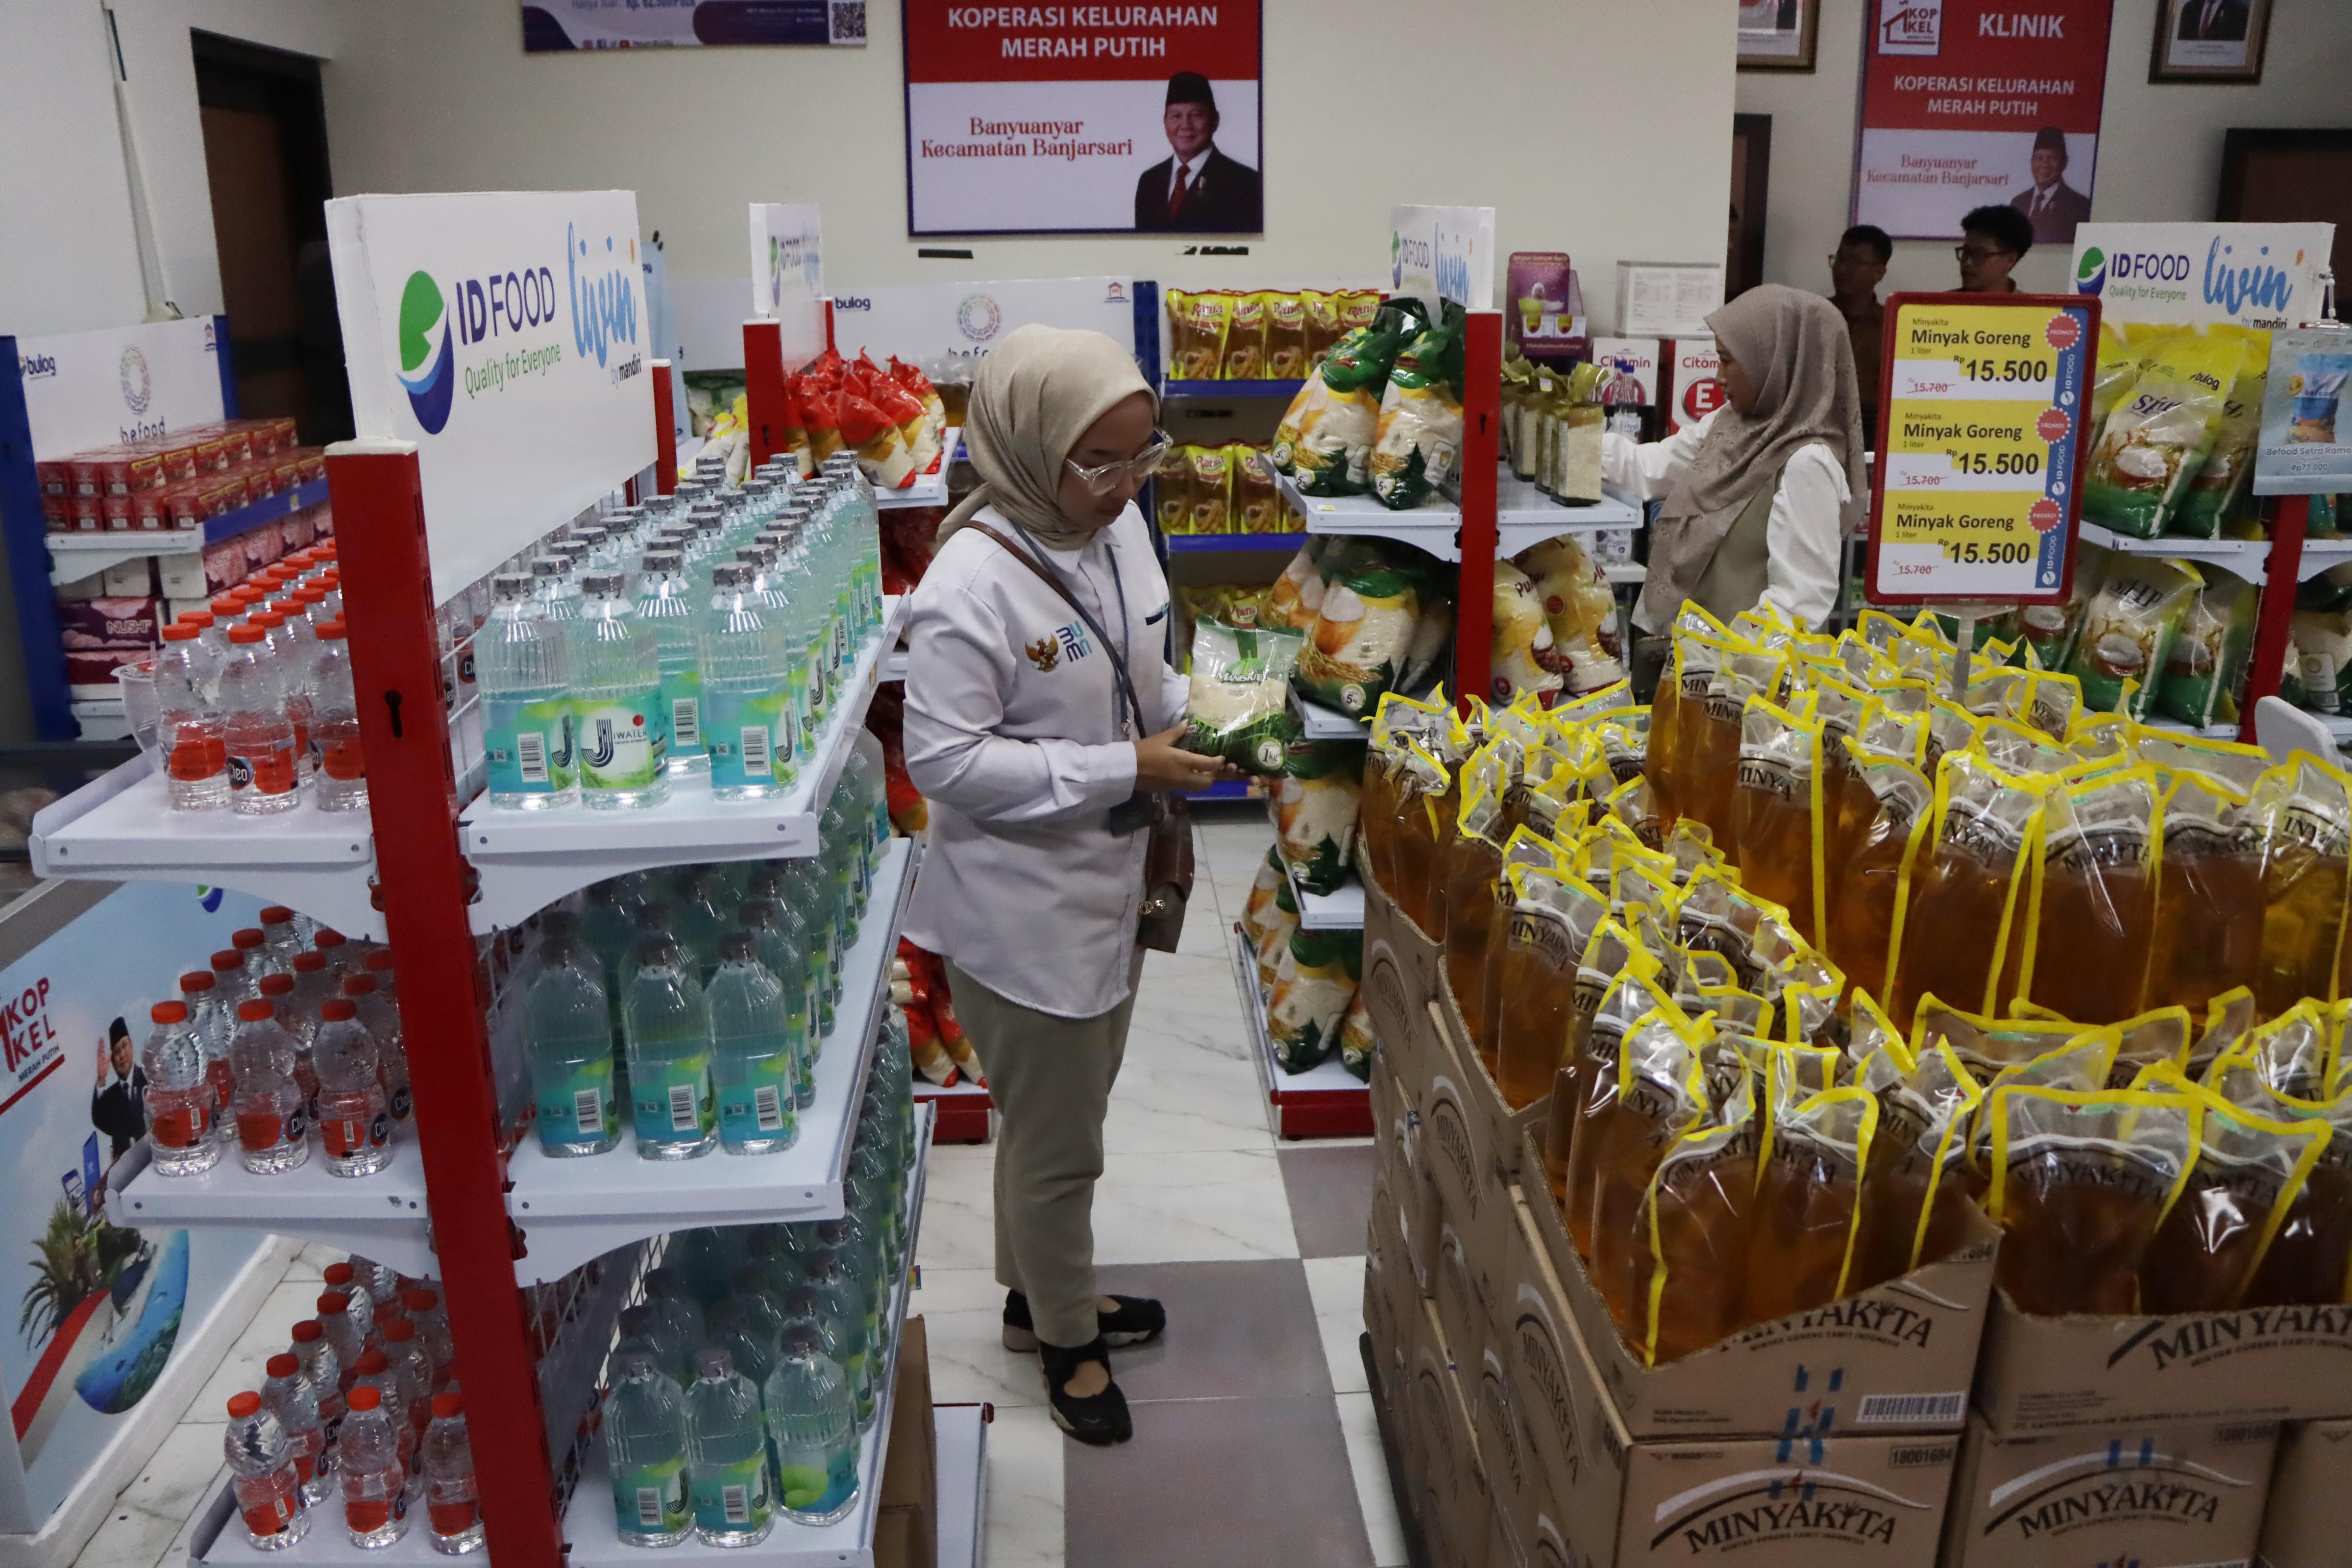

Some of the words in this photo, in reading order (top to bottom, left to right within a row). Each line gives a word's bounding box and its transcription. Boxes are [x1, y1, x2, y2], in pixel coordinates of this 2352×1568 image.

[949, 8, 1065, 27] KOPERASI
[1072, 6, 1218, 26] KELURAHAN
[1909, 7, 1937, 21] KOP
[1908, 21, 1934, 34] KEL
[1979, 13, 2065, 38] KLINIK
[1002, 38, 1087, 58] MERAH
[1094, 37, 1166, 57] PUTIH
[1893, 75, 1973, 92] KOPERASI
[1976, 77, 2075, 95] KELURAHAN
[1927, 99, 1985, 114] MERAH
[1989, 100, 2038, 116] PUTIH
[969, 117, 1084, 140] Banyuanyar
[921, 140, 1027, 158] Kecamatan
[1032, 138, 1133, 161] Banjarsari
[1901, 154, 1978, 172] Banyuanyar
[1866, 170, 1938, 185] Kecamatan
[1941, 172, 2009, 188] Banjarsari
[2108, 285, 2136, 301] Quality
[2137, 286, 2149, 299] for
[2150, 287, 2186, 302] Everyone
[835, 296, 871, 312] bulog
[1912, 318, 1949, 327] Minyakita
[2253, 317, 2288, 329] mandiri
[1911, 329, 1969, 344] Minyak
[1974, 331, 2031, 347] Goreng
[25, 353, 56, 376] bulog
[465, 356, 504, 400] Quality
[506, 352, 520, 376] for
[521, 343, 562, 375] Everyone
[619, 353, 642, 382] mandiri
[1953, 356, 1965, 365] Rp
[1965, 359, 2048, 382] 15.500
[2195, 371, 2220, 391] bulog
[1696, 383, 1714, 409] E
[1905, 412, 1942, 421] Minyakita
[1904, 424, 1961, 439] Minyak
[1966, 425, 2022, 441] Goreng
[2266, 447, 2298, 456] Befood
[2300, 446, 2324, 456] Setra
[1945, 449, 1958, 458] Rp
[1958, 453, 2039, 475] 15.500
[1897, 502, 1934, 511] Minyakita
[1896, 514, 1954, 529] Minyak
[1959, 515, 2014, 531] Goreng
[1937, 539, 1949, 547] Rp
[1950, 542, 2031, 564] 15.500
[5, 977, 49, 1031] KOP
[12, 1014, 56, 1065] KEL
[18, 1059, 41, 1083] MERAH
[42, 1044, 60, 1063] PUTIH
[2018, 1482, 2219, 1539] MINYAKITA
[1683, 1500, 1895, 1555] MINYAKITA
